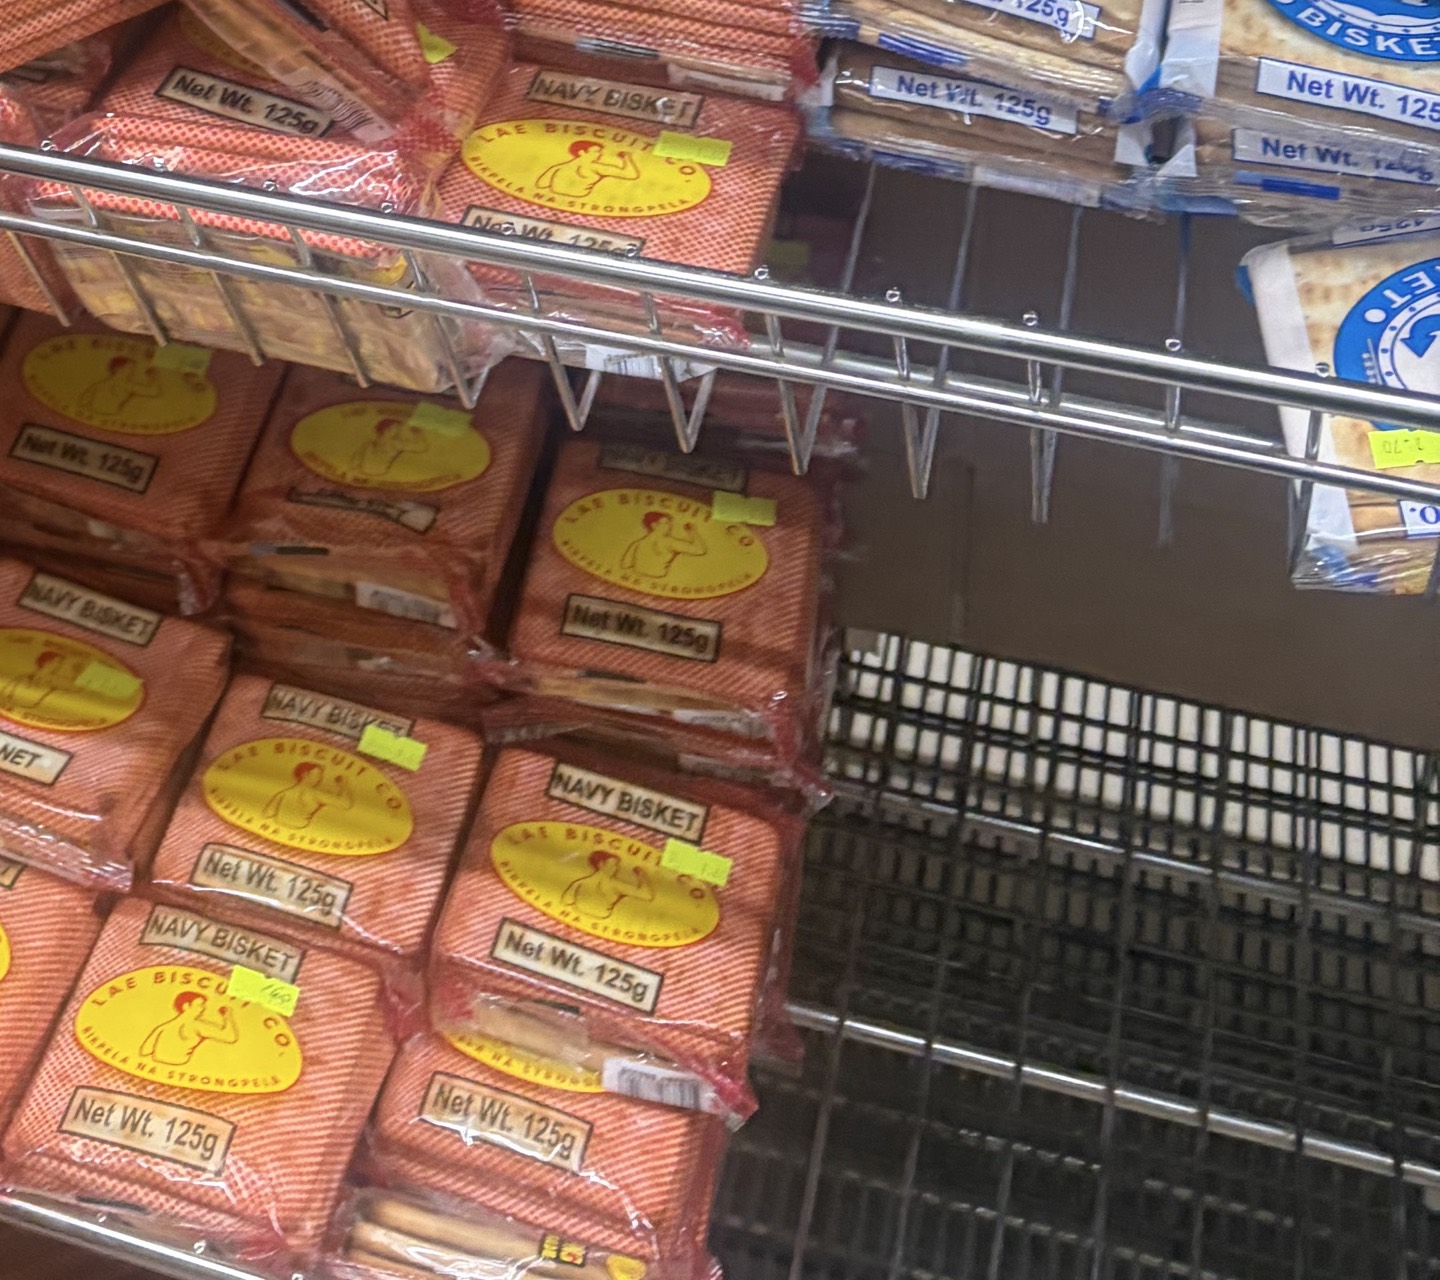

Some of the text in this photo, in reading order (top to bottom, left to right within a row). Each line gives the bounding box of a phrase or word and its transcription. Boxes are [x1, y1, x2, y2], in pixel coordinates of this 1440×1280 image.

[1297, 8, 1440, 58] BISKE
[173, 74, 320, 134] Net Wt. 125g
[534, 75, 694, 122] NAVY BISKET
[895, 74, 943, 98] Net
[992, 94, 1053, 124] 125g
[1284, 70, 1440, 121] Net Wt. 125
[478, 121, 653, 151] LAE BISCUIT
[21, 432, 55, 457] Net
[96, 455, 144, 482] 125g
[32, 579, 151, 637] NAVY BISKET
[571, 604, 711, 655] Net Wt. 125g
[270, 690, 325, 721] NAVY
[555, 771, 701, 832] NAVY BISKET
[202, 849, 339, 916] Net Wt. 125g
[148, 912, 296, 974] NAVY BISKET
[504, 932, 651, 1001] Net Wt. 125g
[82, 1024, 283, 1091] BIKPELA NA STRONGPELA
[75, 1096, 219, 1159] Net Wt. 125g
[432, 1084, 575, 1161] Net Wt. 125g
